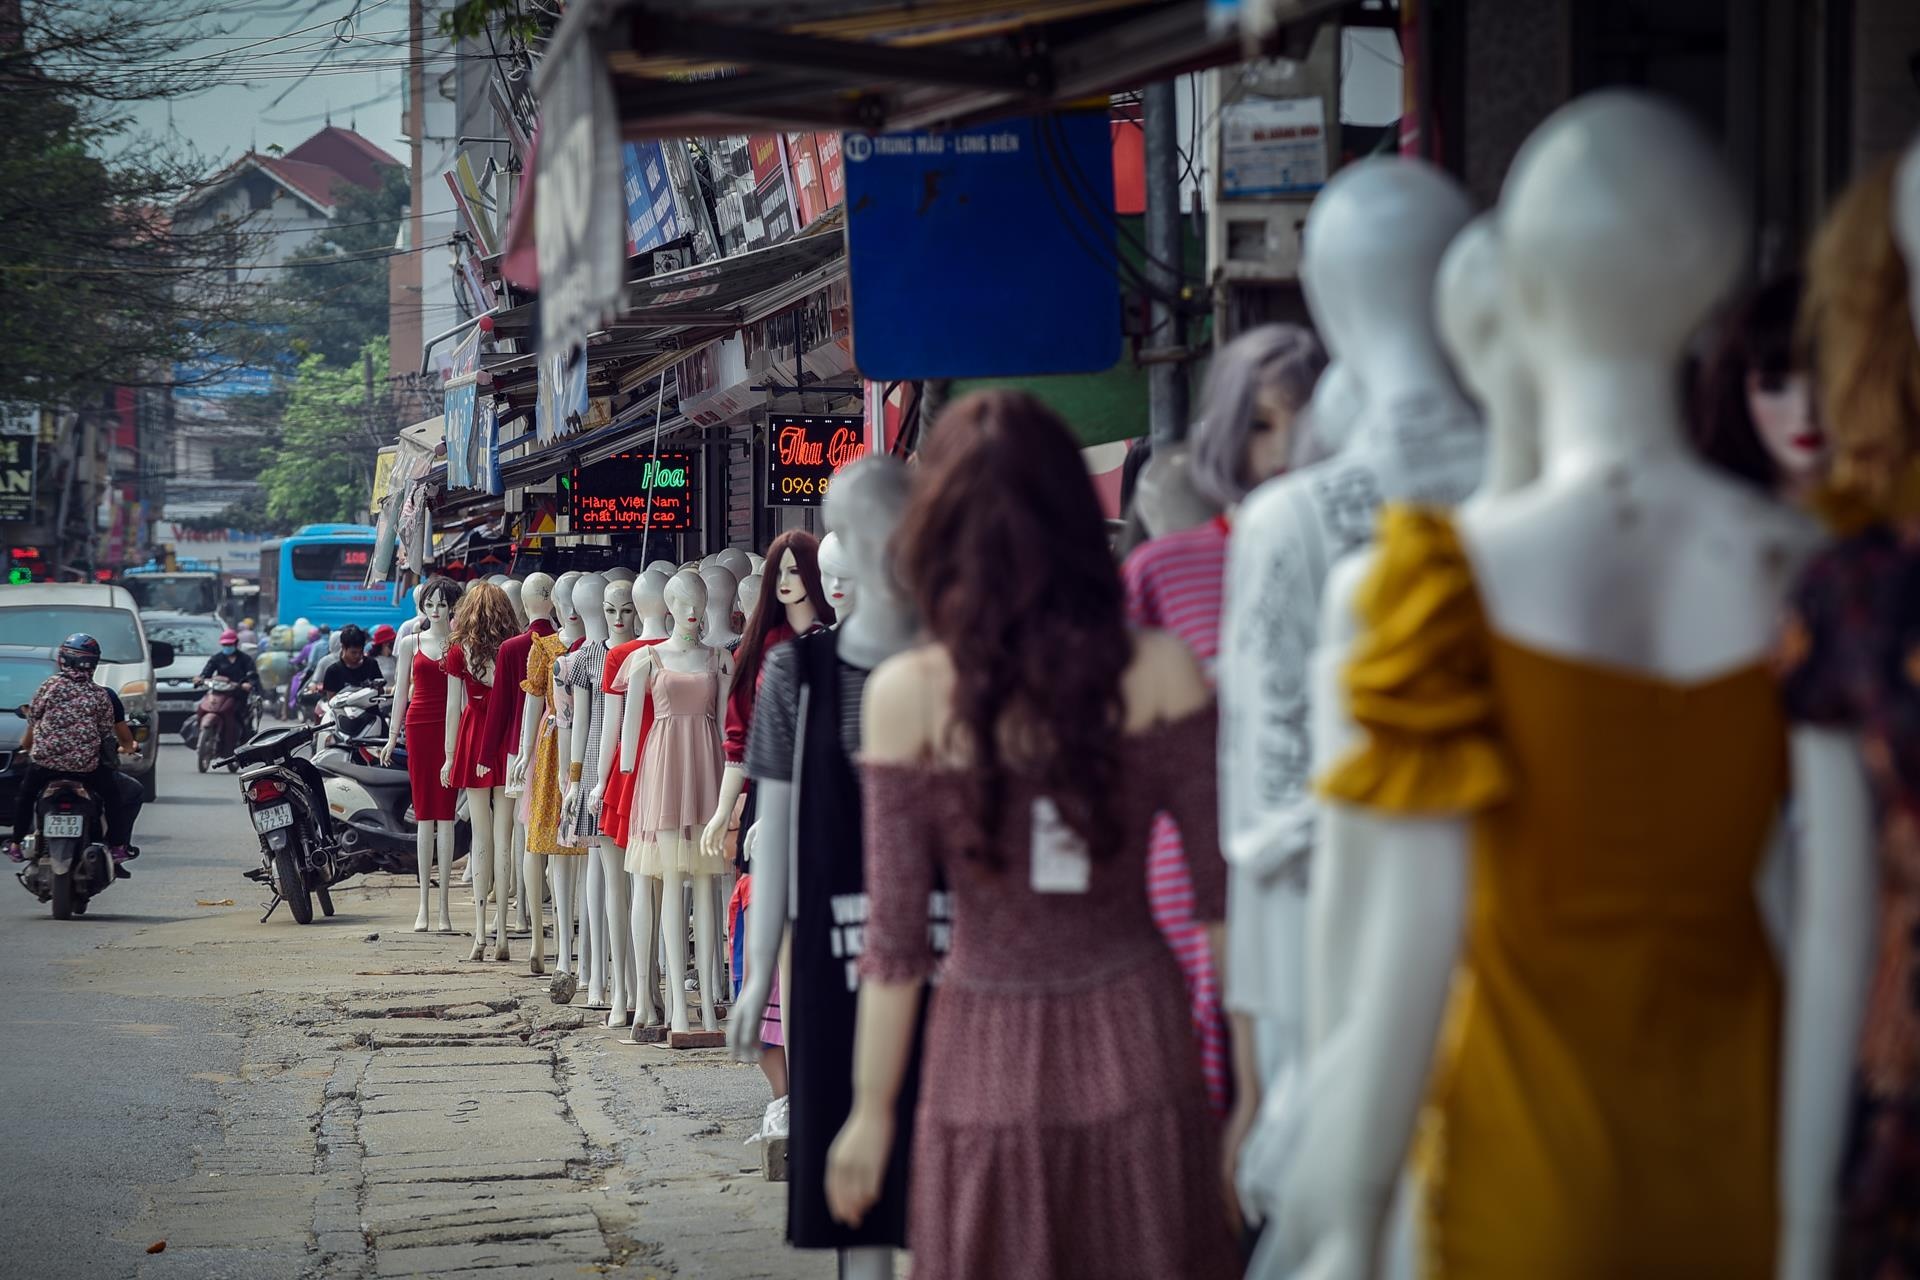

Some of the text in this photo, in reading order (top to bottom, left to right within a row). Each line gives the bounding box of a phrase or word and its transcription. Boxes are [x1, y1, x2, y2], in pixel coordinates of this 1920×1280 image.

[641, 460, 686, 489] Hoa
[781, 477, 814, 494] 096
[582, 496, 616, 510] Hàng
[619, 496, 645, 509] Việt
[651, 496, 680, 507] Nam
[583, 509, 675, 524] chất lượng cao
